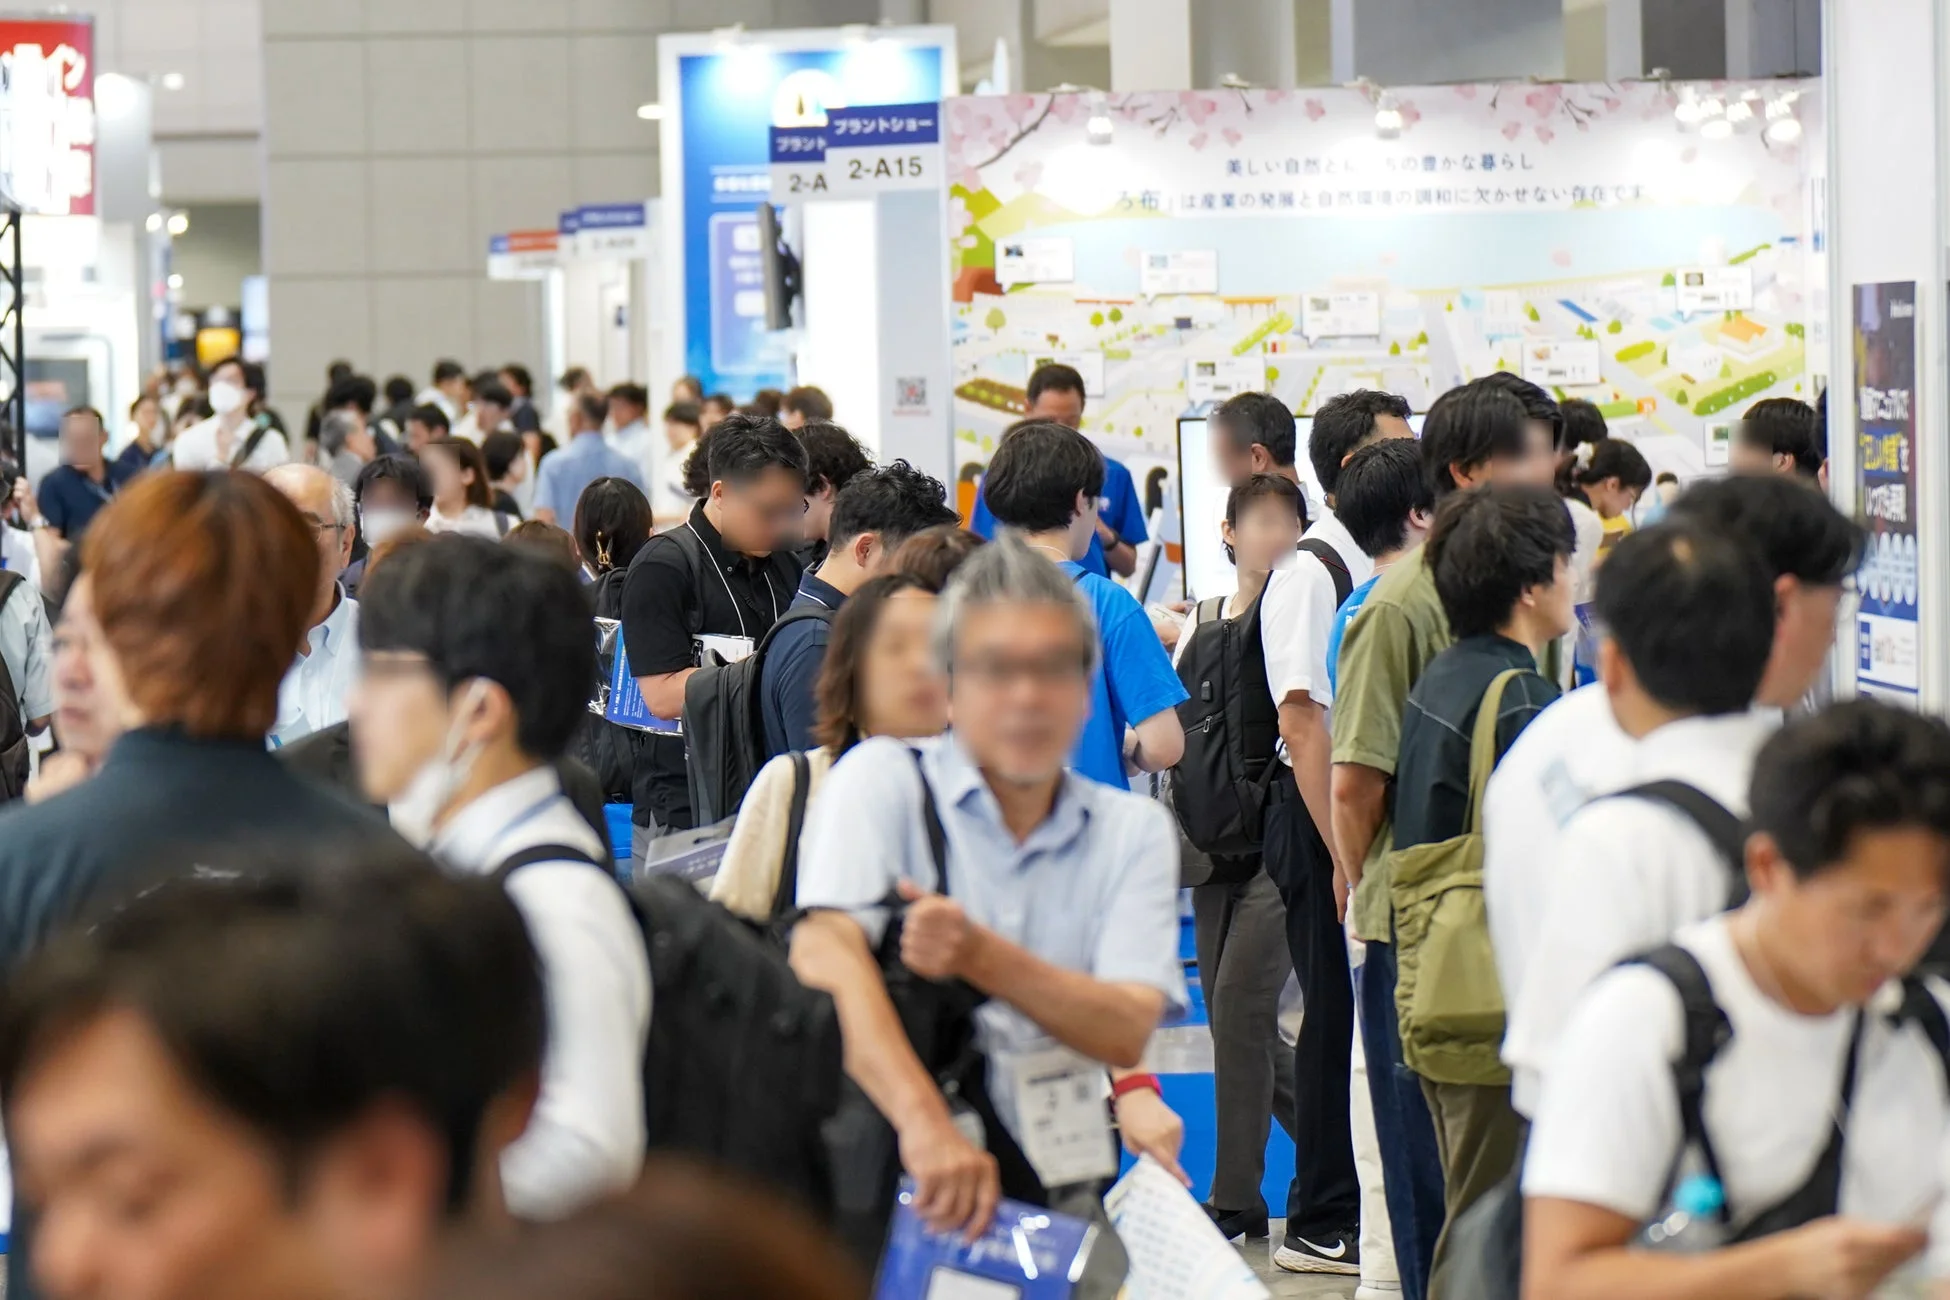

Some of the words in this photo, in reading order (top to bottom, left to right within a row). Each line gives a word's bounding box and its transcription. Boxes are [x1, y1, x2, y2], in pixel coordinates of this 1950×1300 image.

[833, 116, 934, 136] プラントショー
[848, 156, 923, 180] 2-A15
[1226, 153, 1534, 177] 美しい自然とちの豊かな暮らし
[788, 172, 828, 193] 2-A
